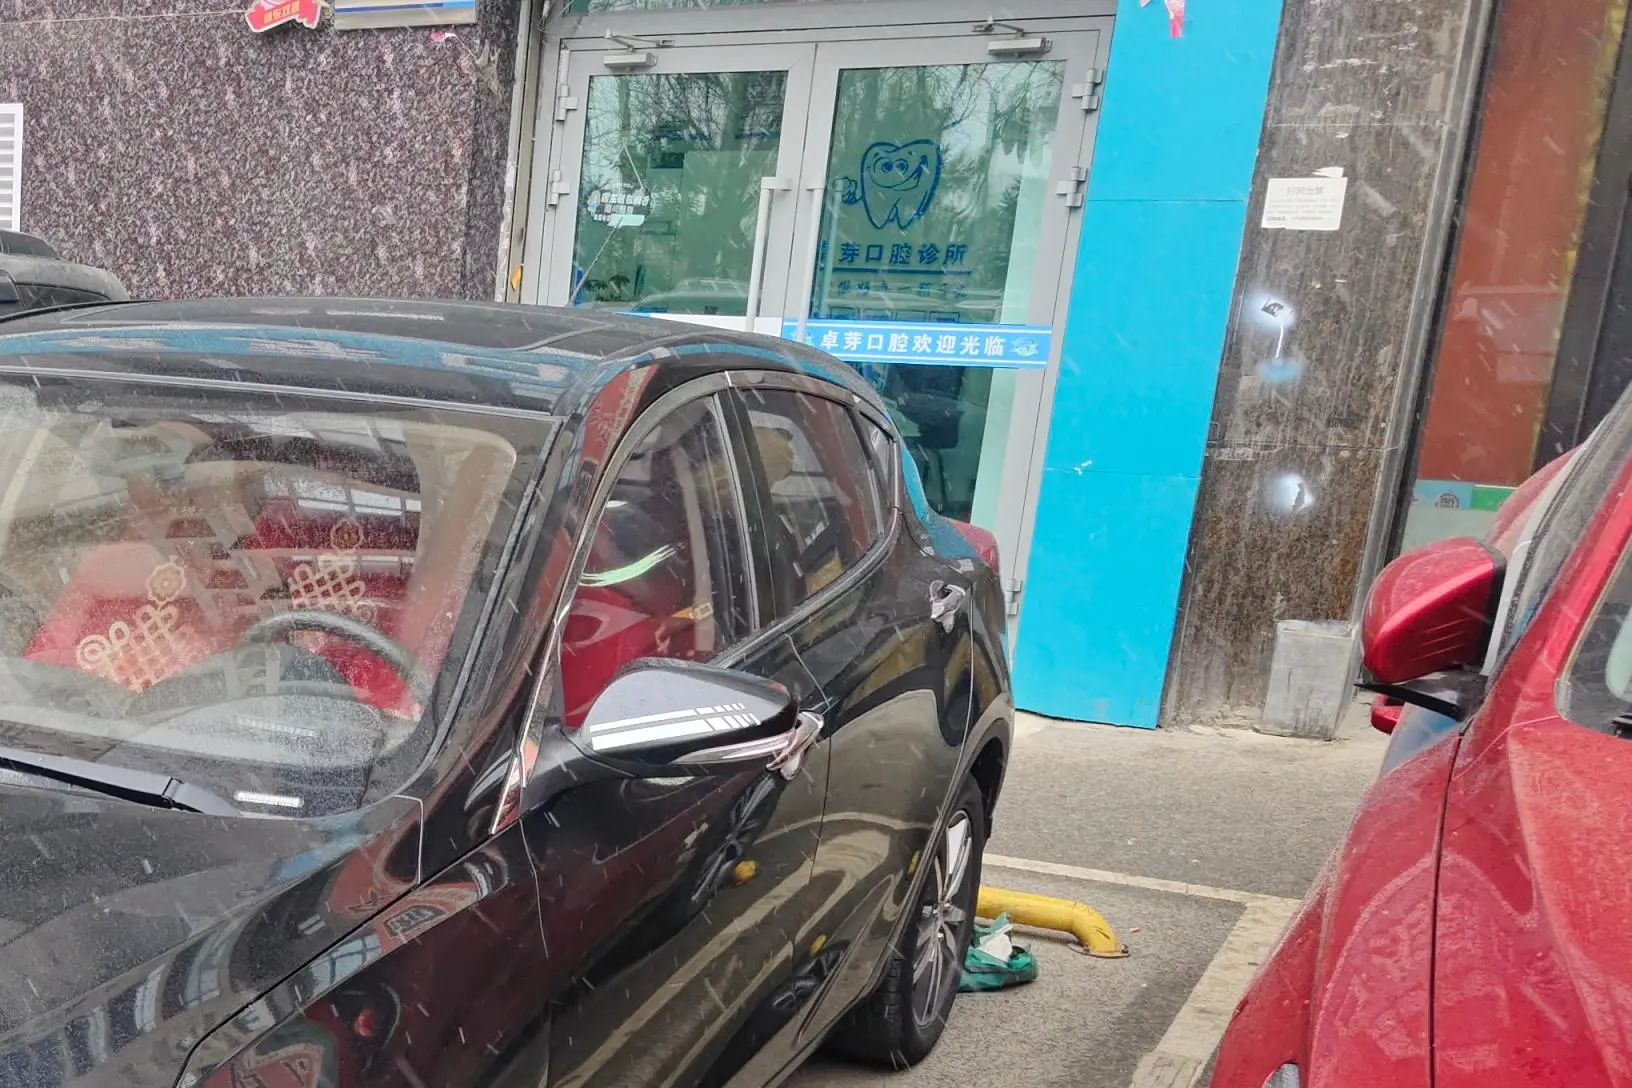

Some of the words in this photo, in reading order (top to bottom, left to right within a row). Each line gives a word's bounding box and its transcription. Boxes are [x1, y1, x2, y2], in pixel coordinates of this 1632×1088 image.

[819, 329, 1006, 357] 卓芽口腔欢迎光临
